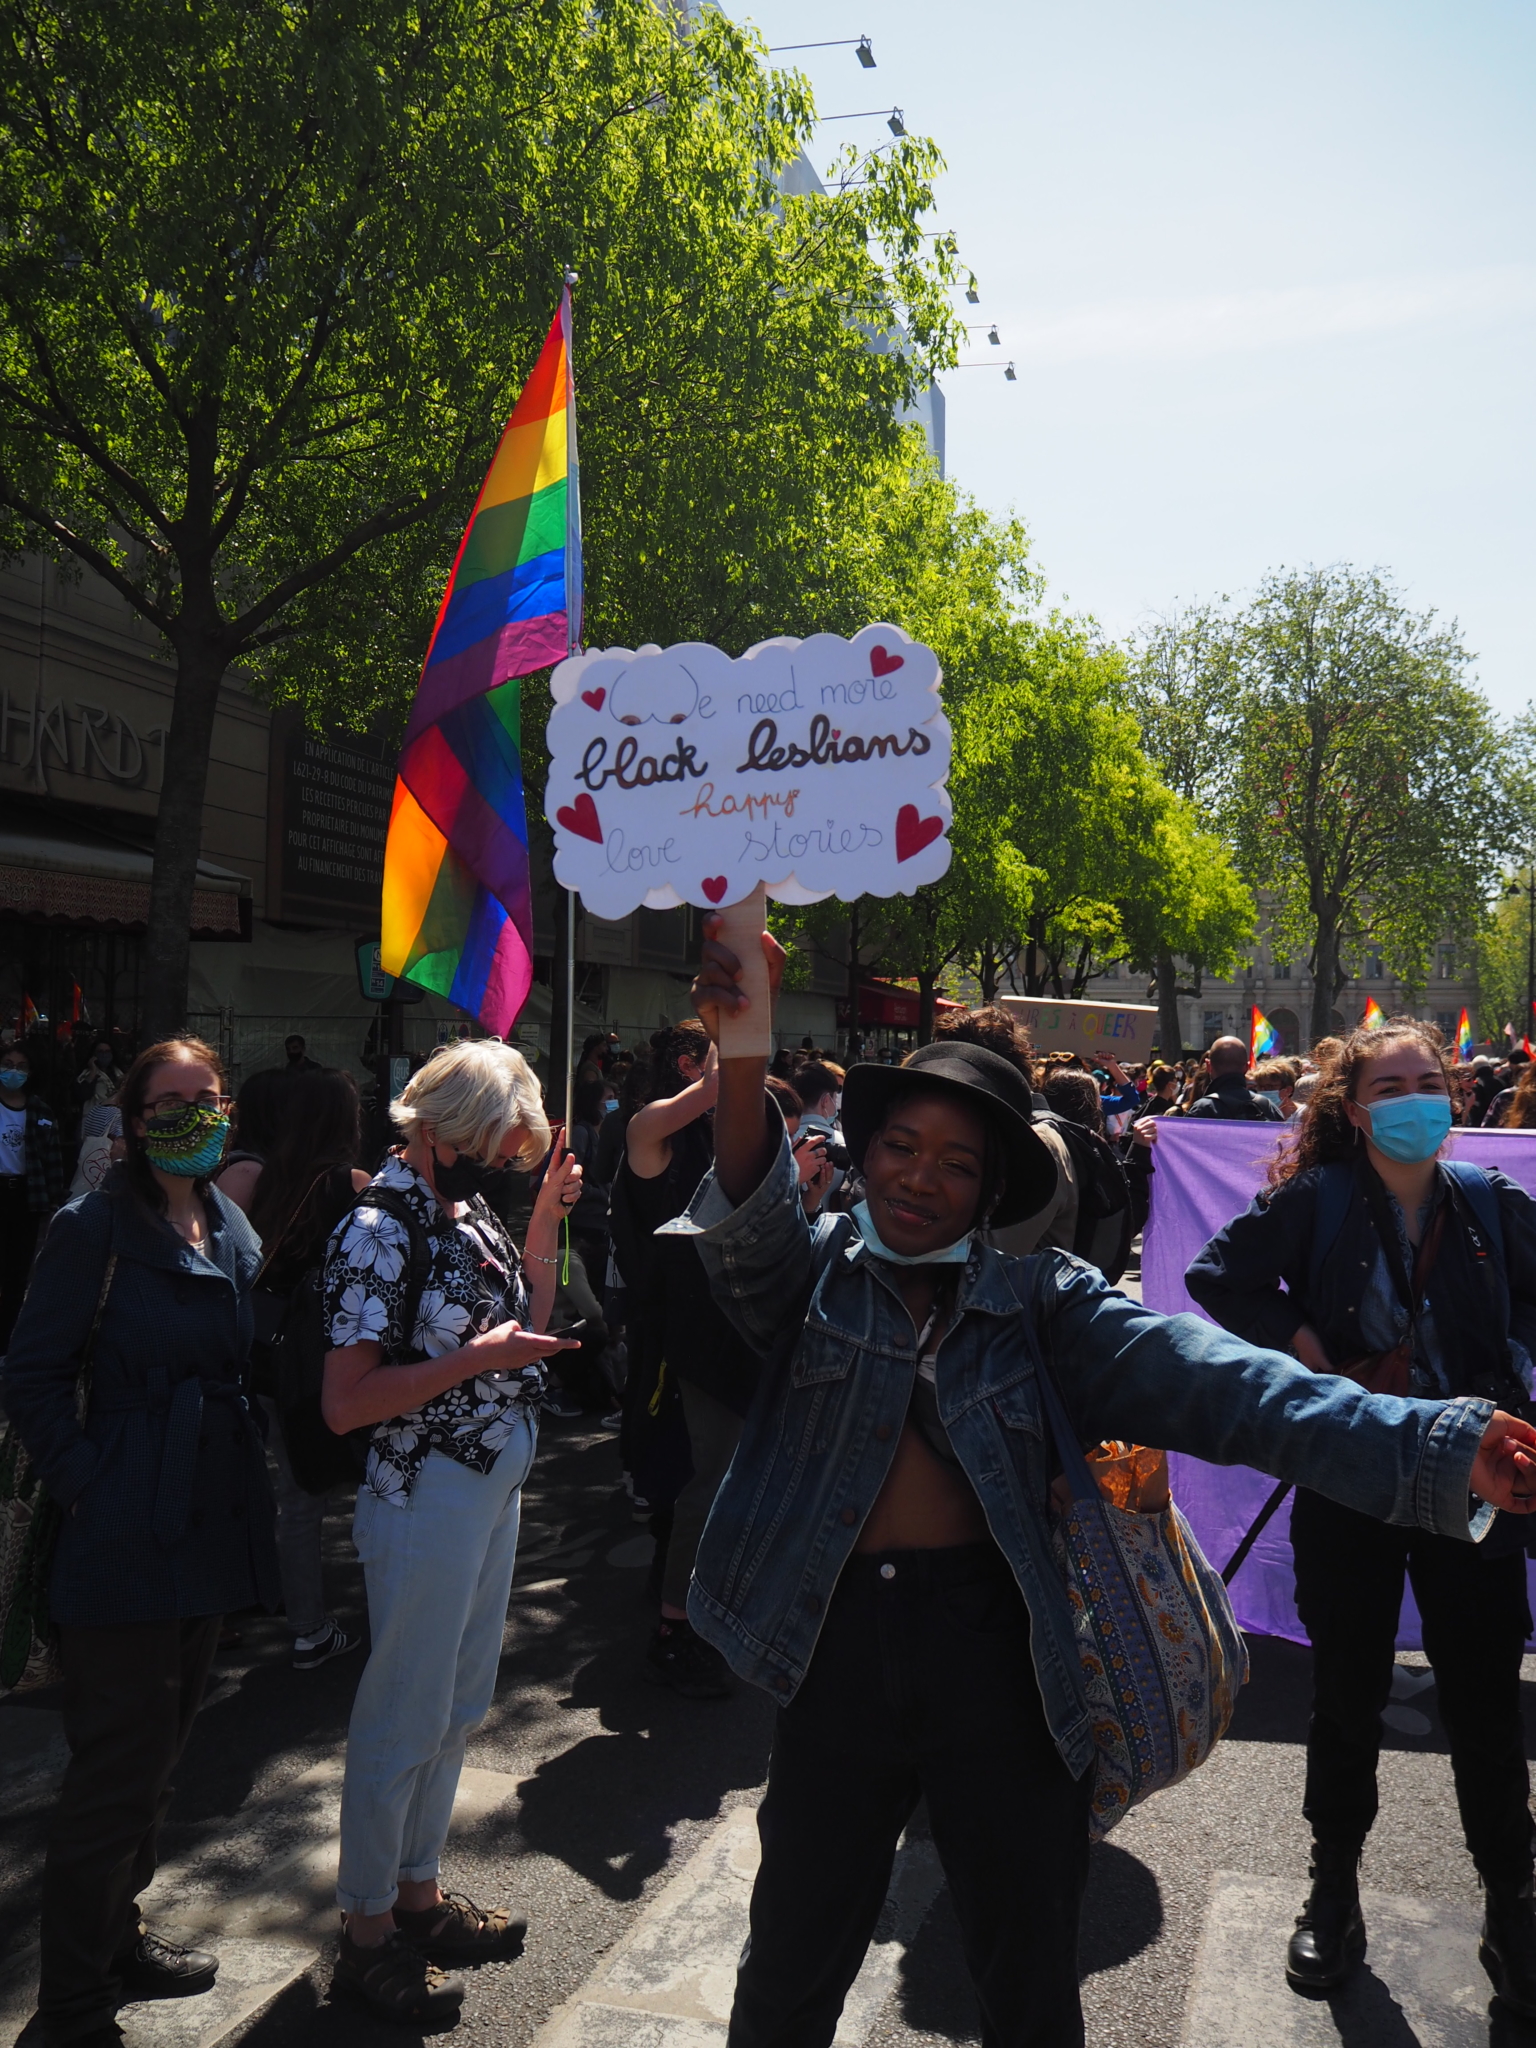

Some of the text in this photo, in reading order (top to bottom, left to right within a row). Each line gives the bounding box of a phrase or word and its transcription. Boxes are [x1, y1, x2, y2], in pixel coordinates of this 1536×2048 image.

[608, 664, 898, 726] We need more
[304, 740, 395, 782] EN APPLICATION DE L'ARTICLE
[575, 713, 932, 791] black lesbians
[293, 760, 330, 784] L621-29-8
[330, 771, 341, 787] DU
[340, 774, 357, 793] CODE
[357, 779, 367, 795] DU
[302, 786, 314, 803] LES
[314, 788, 346, 811] RECETTES
[345, 801, 375, 820] PERÇUES
[374, 806, 388, 823] PAR
[679, 782, 801, 821] happy
[302, 809, 350, 835] PROPRIÉTAIRE
[350, 822, 361, 837] DU
[288, 829, 308, 848] POUR
[308, 835, 321, 851] CET
[321, 837, 357, 859] AFFICHAGE
[356, 845, 372, 862] SONT
[600, 819, 884, 878] love stories
[297, 855, 308, 871] AU
[308, 858, 354, 879] FINANCEMENT
[354, 866, 366, 882] DES
[1083, 1013, 1138, 1040] QUEER
